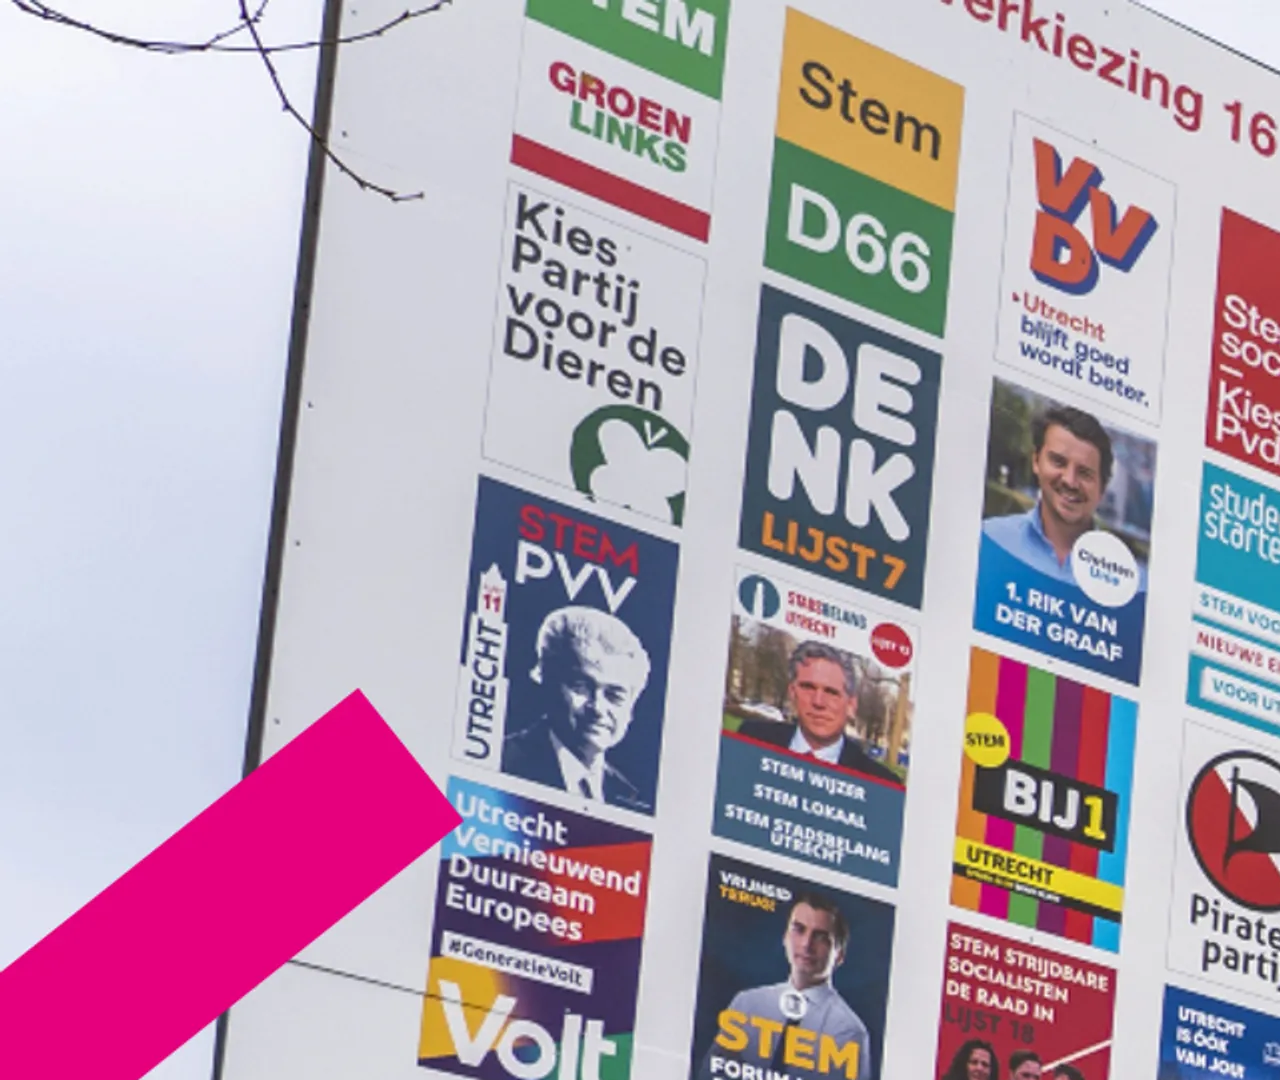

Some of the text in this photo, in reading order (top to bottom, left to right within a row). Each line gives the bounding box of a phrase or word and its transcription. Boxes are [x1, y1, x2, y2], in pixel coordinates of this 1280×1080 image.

[592, 0, 716, 57] EM
[549, 61, 691, 144] GROEN
[941, 0, 1203, 132] erkiezing
[1225, 101, 1277, 157] 16
[570, 100, 687, 172] LINKS
[799, 61, 941, 160] Stem
[516, 194, 617, 267] Kies
[787, 182, 930, 292] D66
[1030, 137, 1159, 296] VVD
[511, 234, 640, 327] Partij
[507, 284, 686, 377] voor de
[1020, 314, 1130, 376] blijft goed
[1023, 291, 1106, 342] Utrecht
[503, 318, 662, 411] Dieren
[1019, 340, 1150, 407] wordt beter.
[519, 504, 639, 576] STEM
[762, 510, 907, 590] LIJST 7
[483, 594, 501, 613] 11
[515, 539, 637, 614] PVV
[1200, 592, 1243, 621] STEM
[995, 603, 1123, 663] DER GRAAF
[1005, 582, 1117, 638] 1. RIK VAN
[1197, 631, 1263, 667] NIEUWE
[465, 618, 502, 760] UTRECHT
[1212, 677, 1259, 707] VOOR
[966, 732, 1005, 748] STEM
[754, 784, 866, 830] STEM LOKAAL
[760, 757, 866, 802] STEM WIJZER
[1004, 768, 1106, 841] BIJ1
[455, 791, 568, 846] Utrecht
[724, 804, 890, 865] STEM STADSBELANG
[450, 853, 595, 915] Duurzaam
[454, 826, 641, 896] Vernieuwend
[967, 845, 1054, 886] UTRECHT
[446, 884, 583, 942] Europees
[449, 940, 583, 987] #GeneratieVolt
[948, 956, 1069, 1004] SOCIALISTEN
[950, 933, 1108, 993] STEM STRIJDBARE
[945, 1003, 1035, 1044] LIJST 18
[946, 980, 1054, 1024] DE RAAD IN
[1177, 1005, 1246, 1039] UTRECHT
[715, 1008, 861, 1080] STEM
[1175, 1046, 1207, 1069] VAN
[1176, 1025, 1192, 1043] IS
